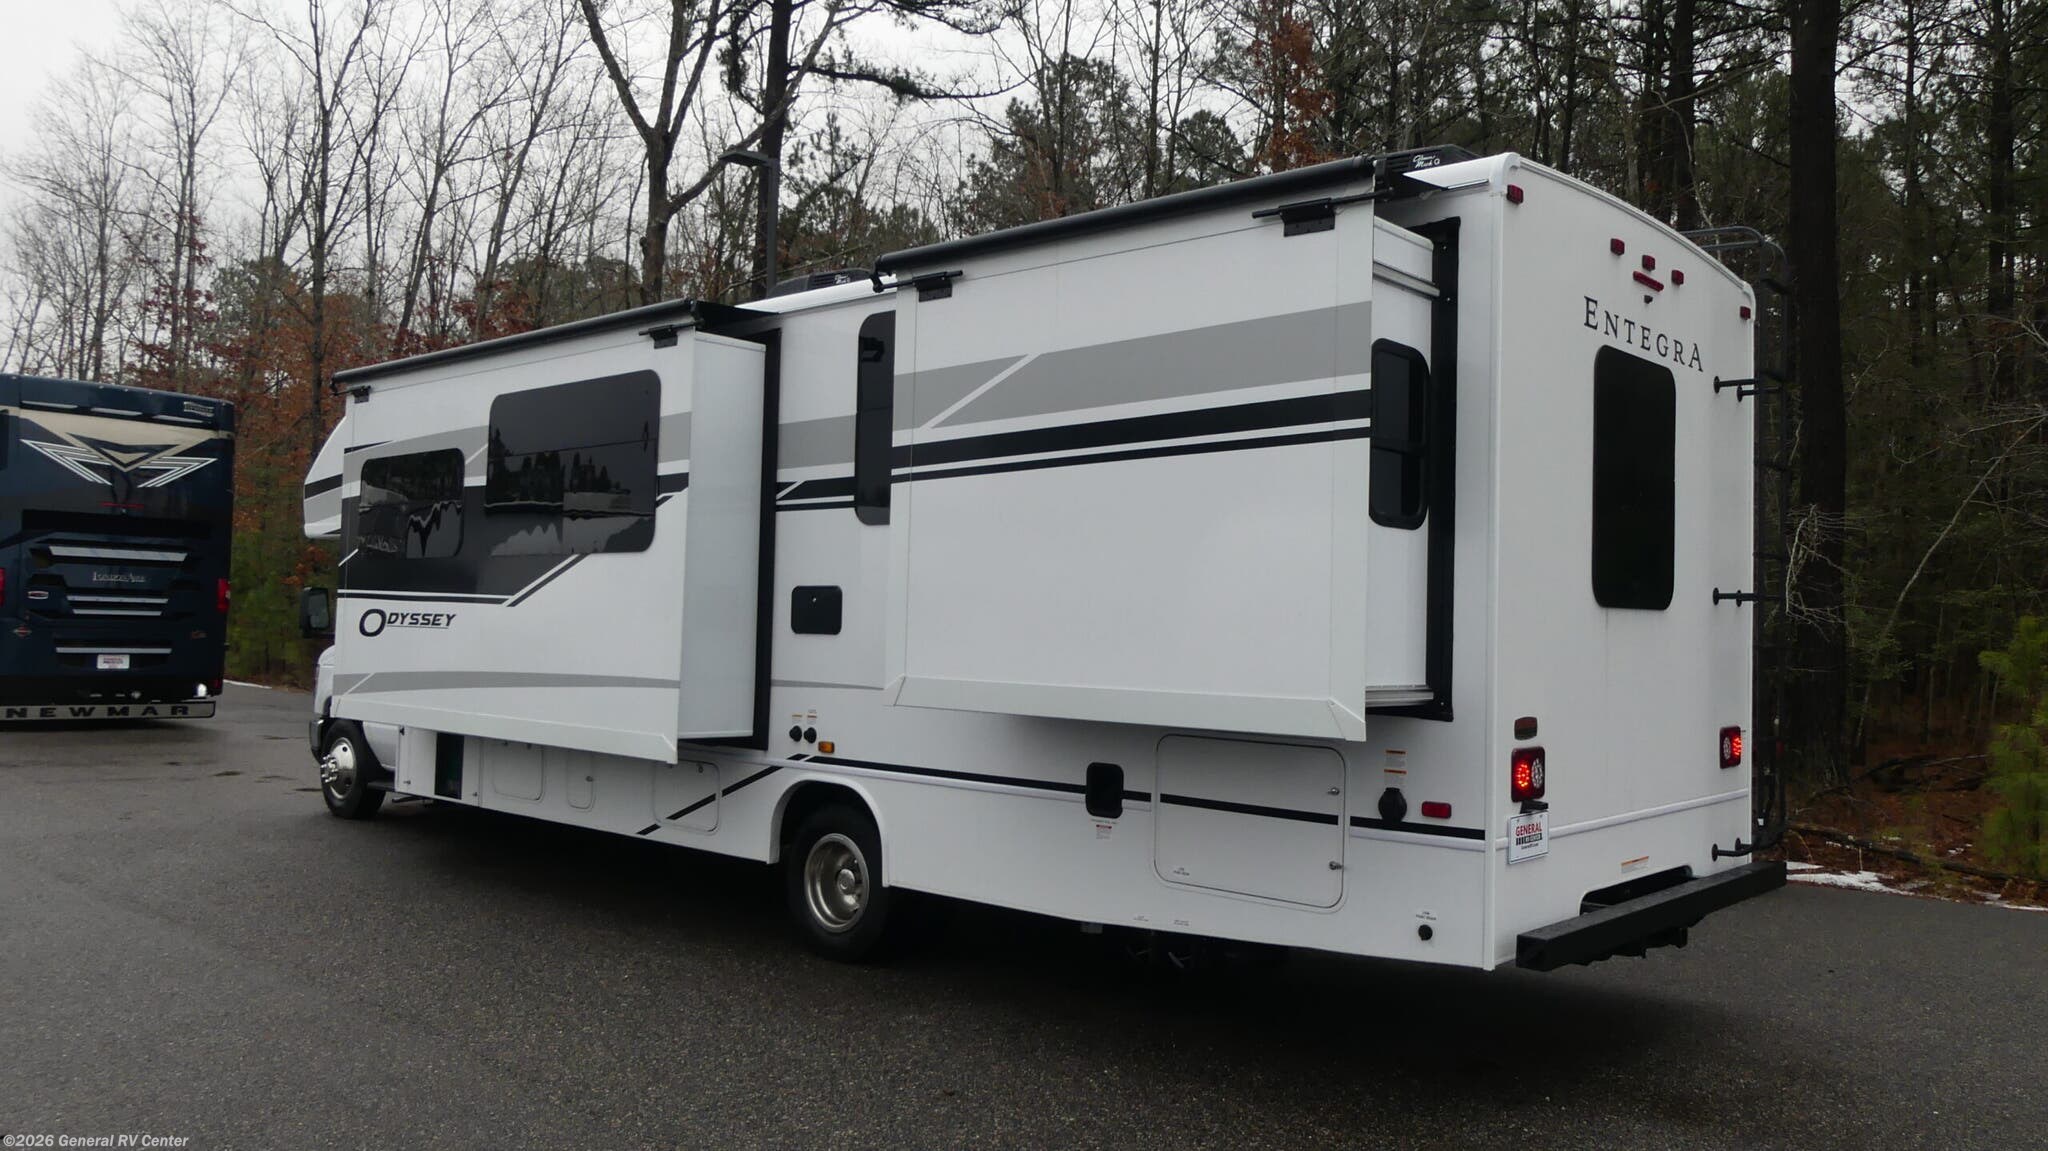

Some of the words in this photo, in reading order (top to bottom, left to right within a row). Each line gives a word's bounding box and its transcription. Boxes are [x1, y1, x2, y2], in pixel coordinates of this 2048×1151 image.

[1583, 295, 1704, 373] ENTEGRA
[359, 608, 456, 637] ODYSSEY
[5, 705, 190, 719] NEWMAR
[1515, 821, 1542, 836] GENERAL
